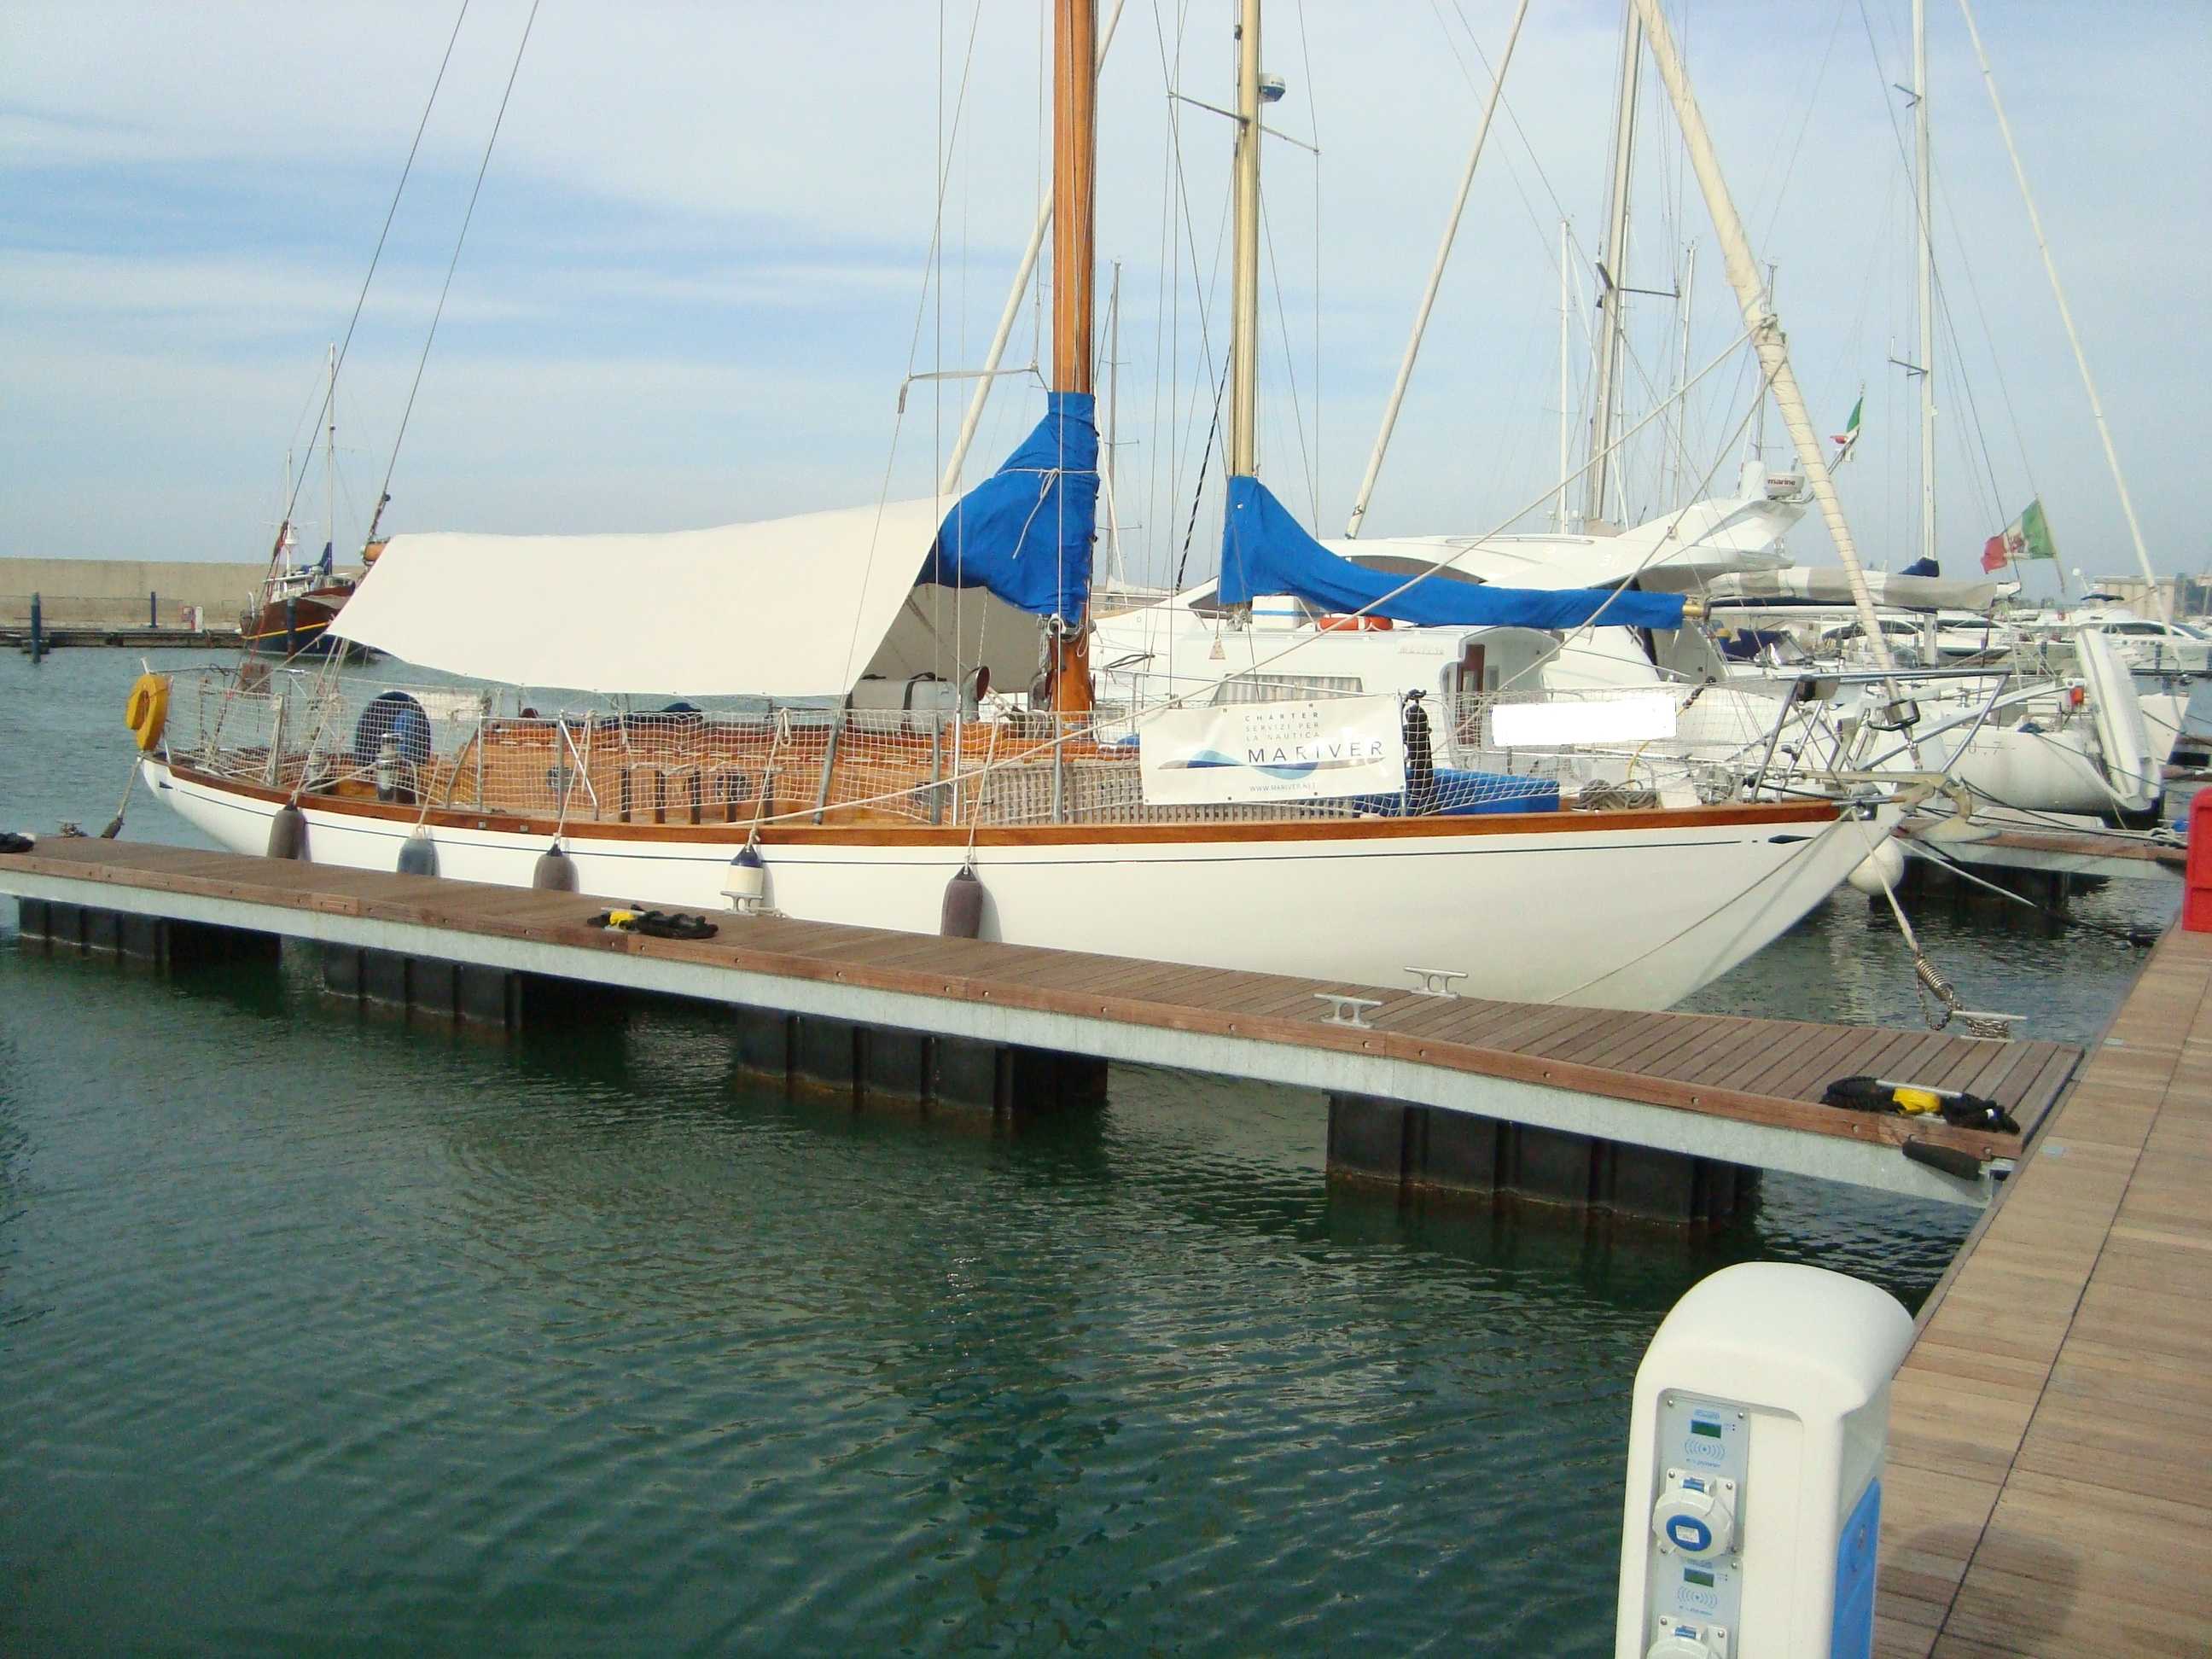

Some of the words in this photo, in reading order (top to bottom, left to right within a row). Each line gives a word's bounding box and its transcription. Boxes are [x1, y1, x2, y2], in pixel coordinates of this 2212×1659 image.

[1245, 712, 1318, 721] CHARTER
[1298, 722, 1319, 731] PER
[1268, 731, 1320, 741] NAUTICA
[1249, 741, 1382, 762] MARIVER
